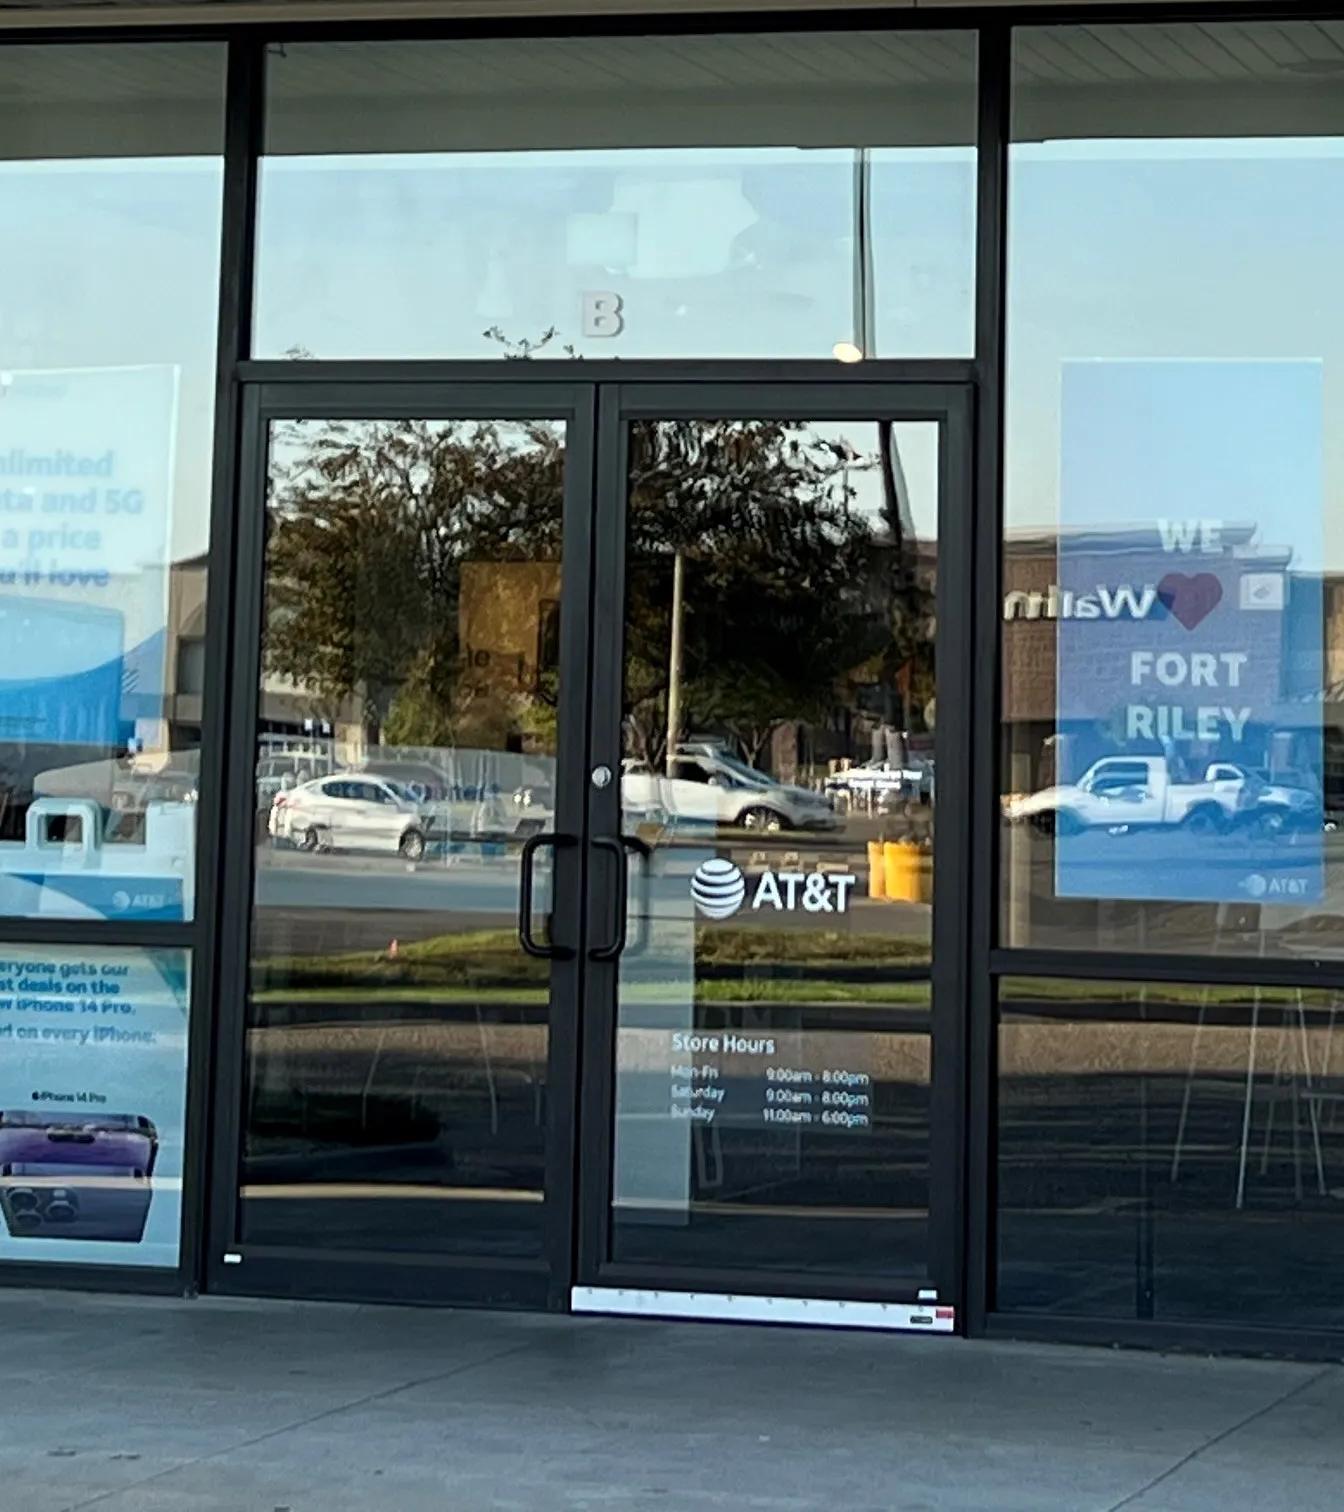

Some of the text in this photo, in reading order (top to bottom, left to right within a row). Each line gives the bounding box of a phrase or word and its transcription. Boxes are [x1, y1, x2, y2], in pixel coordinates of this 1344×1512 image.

[582, 289, 624, 338] B
[40, 488, 97, 514] and
[104, 489, 145, 515] 5G
[2, 530, 18, 548] a
[27, 523, 103, 555] price
[1158, 519, 1223, 553] WE
[49, 557, 111, 588] love
[1131, 652, 1247, 687] FORT
[1127, 705, 1251, 742] RILEY
[752, 871, 856, 913] AT&T
[1268, 878, 1308, 894] AT&T
[59, 962, 97, 978] gets
[101, 964, 129, 976] our
[18, 977, 62, 993] deals
[66, 982, 87, 994] on
[90, 979, 120, 994] the
[16, 996, 74, 1012] iPhone
[17, 1025, 38, 1038] on
[41, 1027, 89, 1044] every
[672, 1034, 776, 1055] Store Hours
